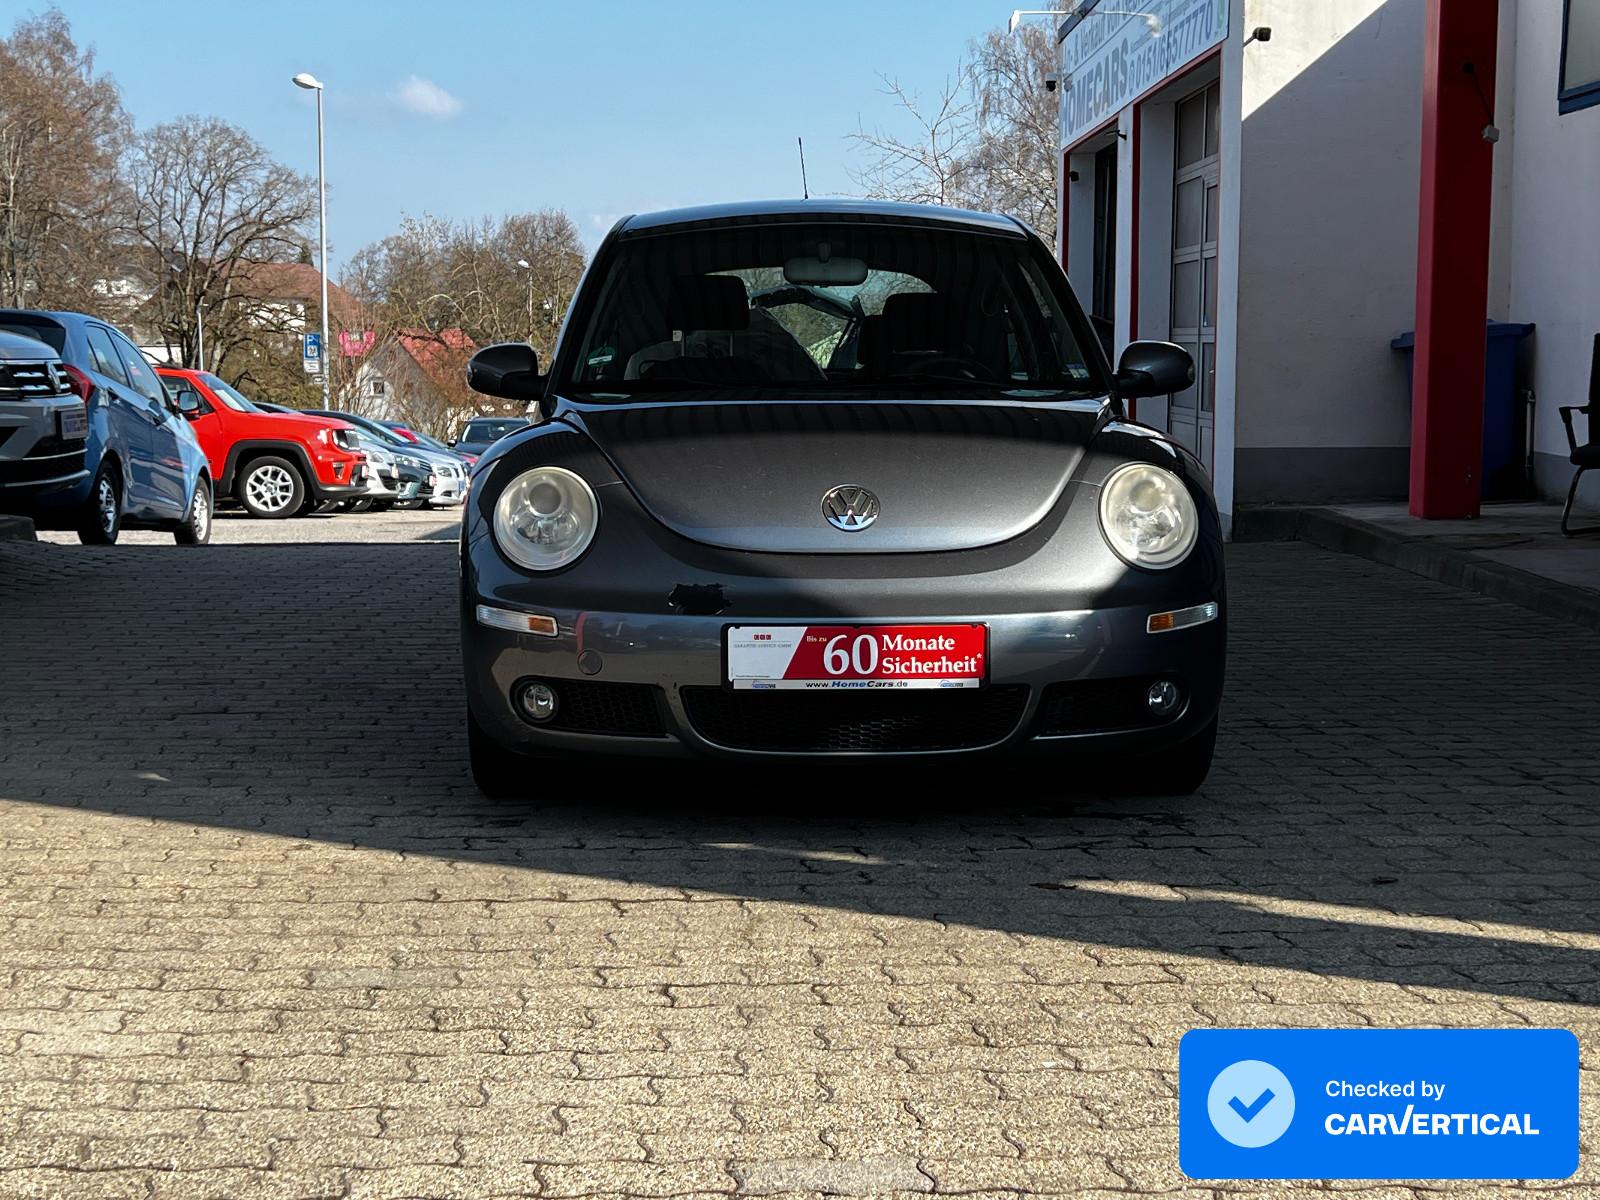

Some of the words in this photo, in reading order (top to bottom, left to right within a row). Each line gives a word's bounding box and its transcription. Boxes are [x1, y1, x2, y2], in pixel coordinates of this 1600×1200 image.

[1063, 38, 1128, 138] HOMECARS
[806, 635, 817, 643] Bis
[881, 634, 956, 651] Monate
[823, 633, 879, 675] 60
[805, 680, 908, 688] www.HomeCars.de
